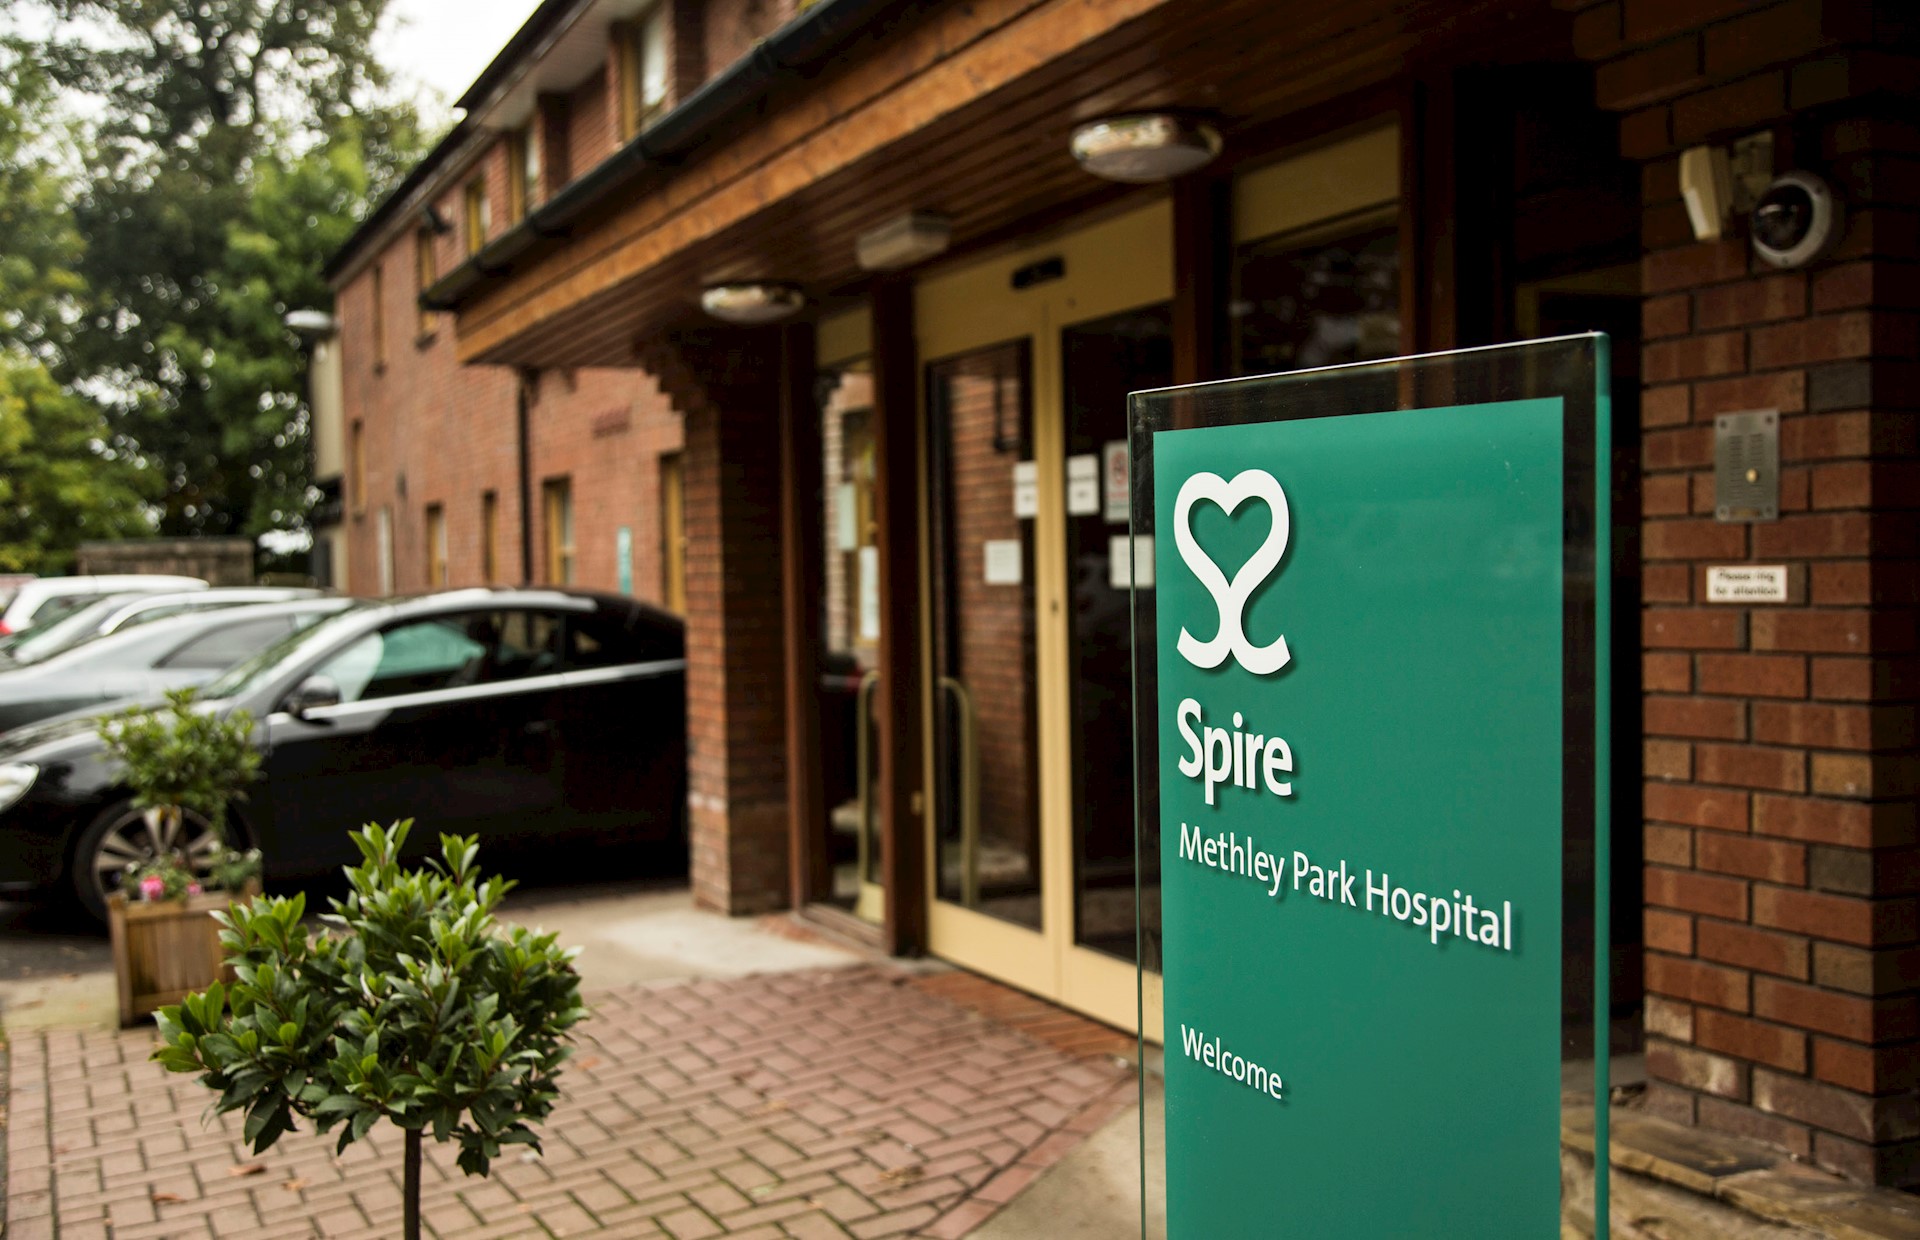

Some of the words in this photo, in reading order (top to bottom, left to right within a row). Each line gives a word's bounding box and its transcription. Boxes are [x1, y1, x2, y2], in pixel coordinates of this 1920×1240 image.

[1176, 697, 1293, 806] Spire
[1179, 822, 1285, 897] Methley
[1293, 850, 1357, 907] Park
[1366, 869, 1512, 951] Hospital
[1180, 1023, 1283, 1100] Welcome
